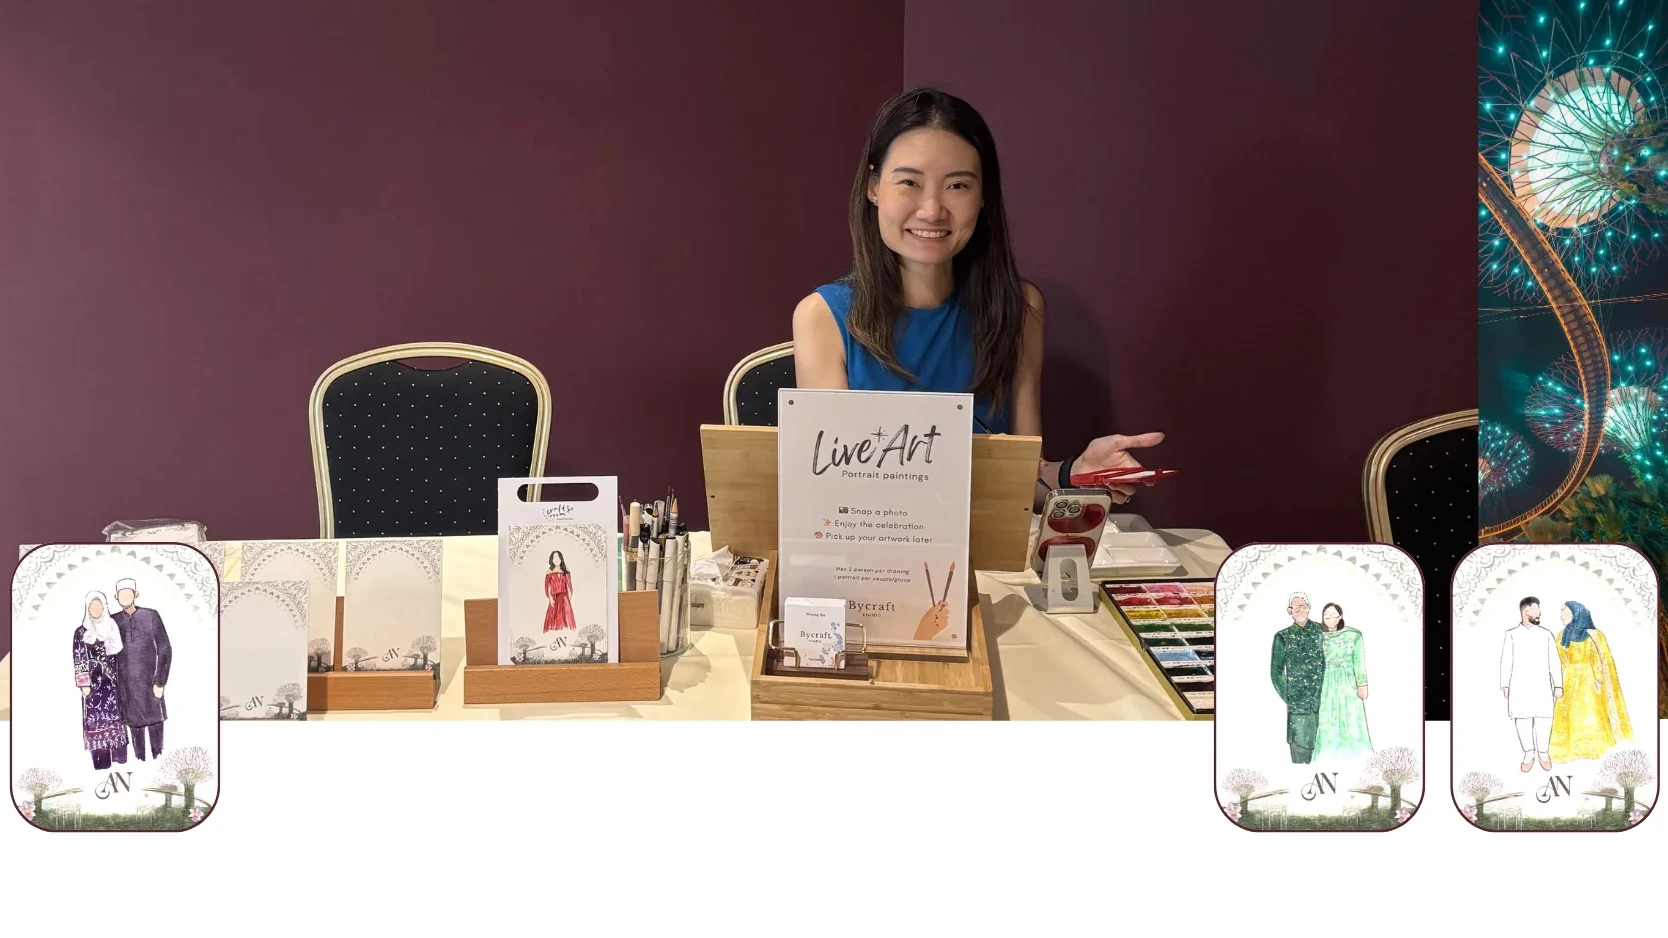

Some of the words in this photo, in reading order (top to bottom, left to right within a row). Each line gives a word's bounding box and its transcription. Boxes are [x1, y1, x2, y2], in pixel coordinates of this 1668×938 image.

[812, 430, 877, 476] Live
[876, 424, 942, 468] Art
[842, 470, 879, 479] Portrait
[883, 471, 929, 482] paintings
[851, 507, 872, 517] Snap
[883, 508, 908, 517] photo
[834, 520, 857, 529] Enjoy
[859, 520, 873, 528] the
[876, 521, 924, 530] celebration
[825, 532, 843, 540] Pick
[845, 534, 856, 542] up
[858, 535, 876, 543] your
[879, 534, 910, 543] artwork
[912, 535, 933, 544] later
[848, 600, 896, 613] Bycraft
[800, 630, 831, 640] Bycraft
